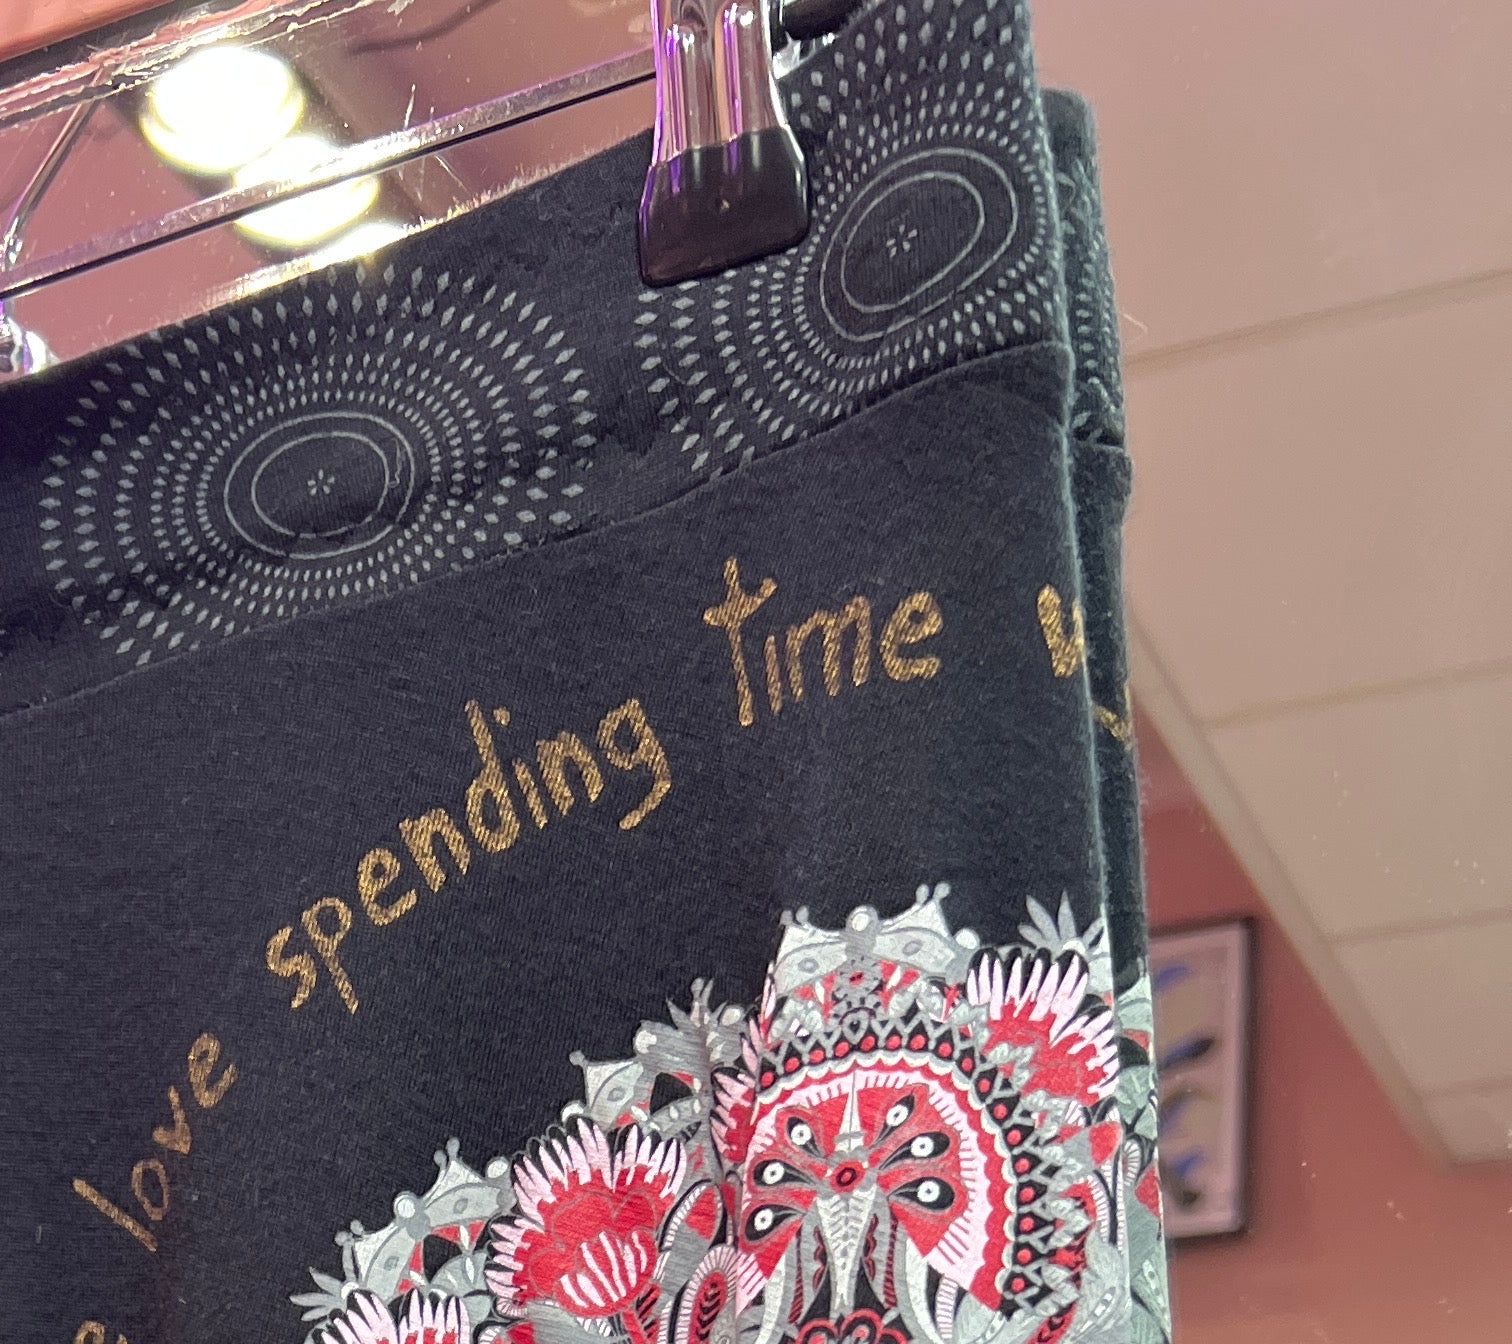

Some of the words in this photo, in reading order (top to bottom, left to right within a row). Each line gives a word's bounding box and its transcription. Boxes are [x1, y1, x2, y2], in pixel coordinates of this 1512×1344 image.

[74, 1032, 239, 1252] love
[264, 697, 672, 1014] spending
[703, 556, 944, 727] time
